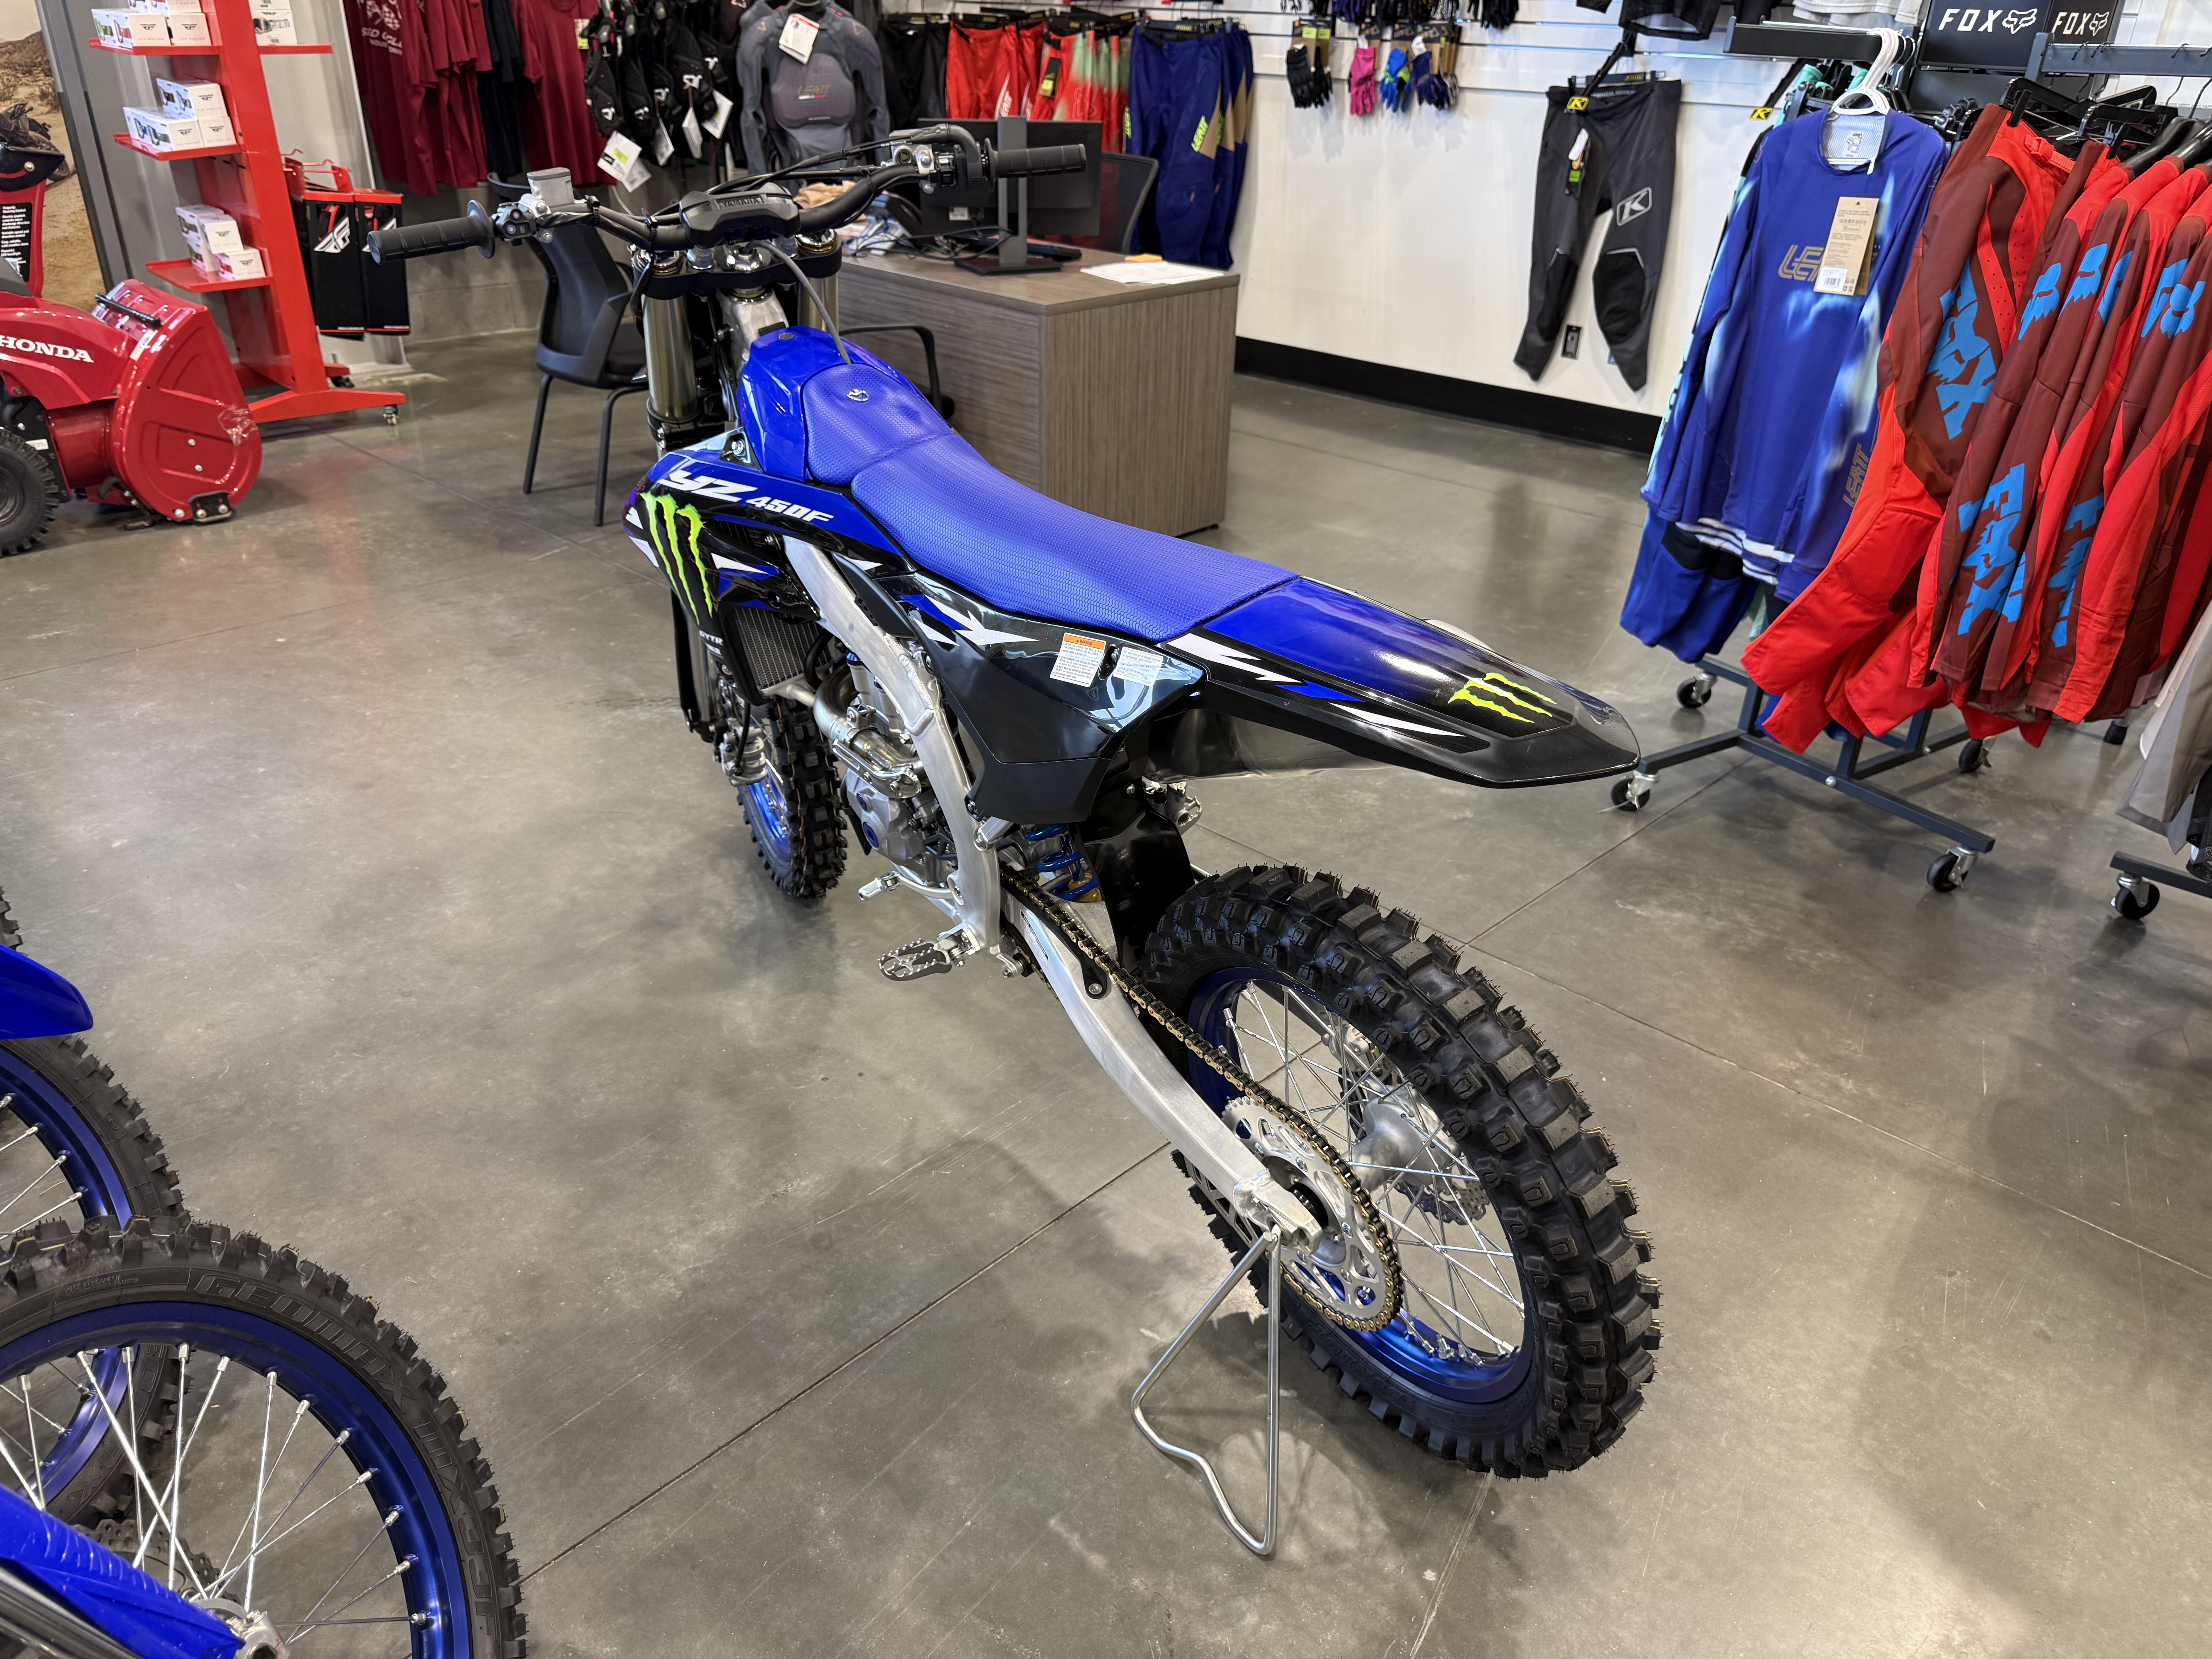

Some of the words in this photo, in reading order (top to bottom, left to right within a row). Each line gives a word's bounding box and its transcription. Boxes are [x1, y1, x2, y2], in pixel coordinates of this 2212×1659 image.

[1938, 9, 2003, 33] FOX
[2052, 12, 2092, 35] FOX
[1753, 109, 1772, 119] K
[1621, 191, 1650, 221] K
[0, 335, 94, 363] HONDA
[658, 469, 758, 502] YZ
[745, 496, 835, 522] 450F
[194, 1274, 417, 1410] GEOMAX
